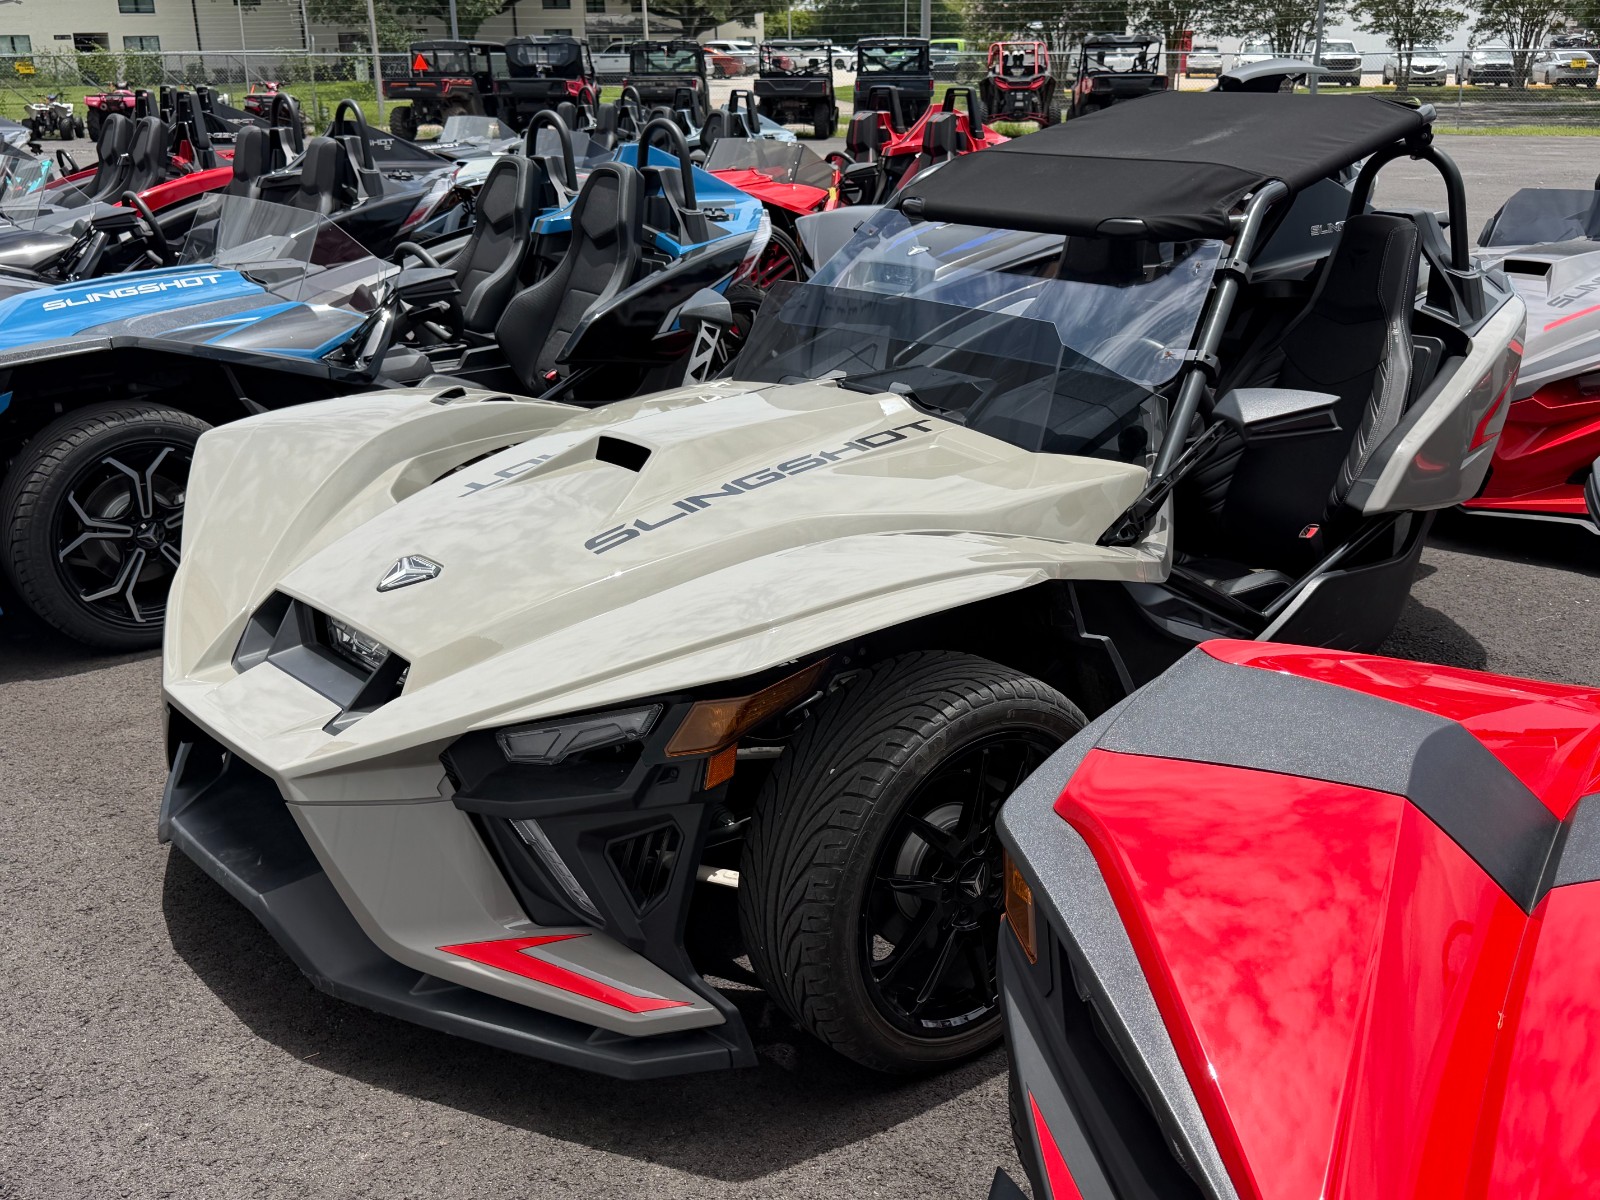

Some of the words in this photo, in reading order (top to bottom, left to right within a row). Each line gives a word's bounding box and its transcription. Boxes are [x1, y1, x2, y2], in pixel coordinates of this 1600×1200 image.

[42, 274, 222, 312] SLINGSHOT
[1546, 276, 1600, 308] SLIN
[584, 419, 931, 555] SLINGSHOT
